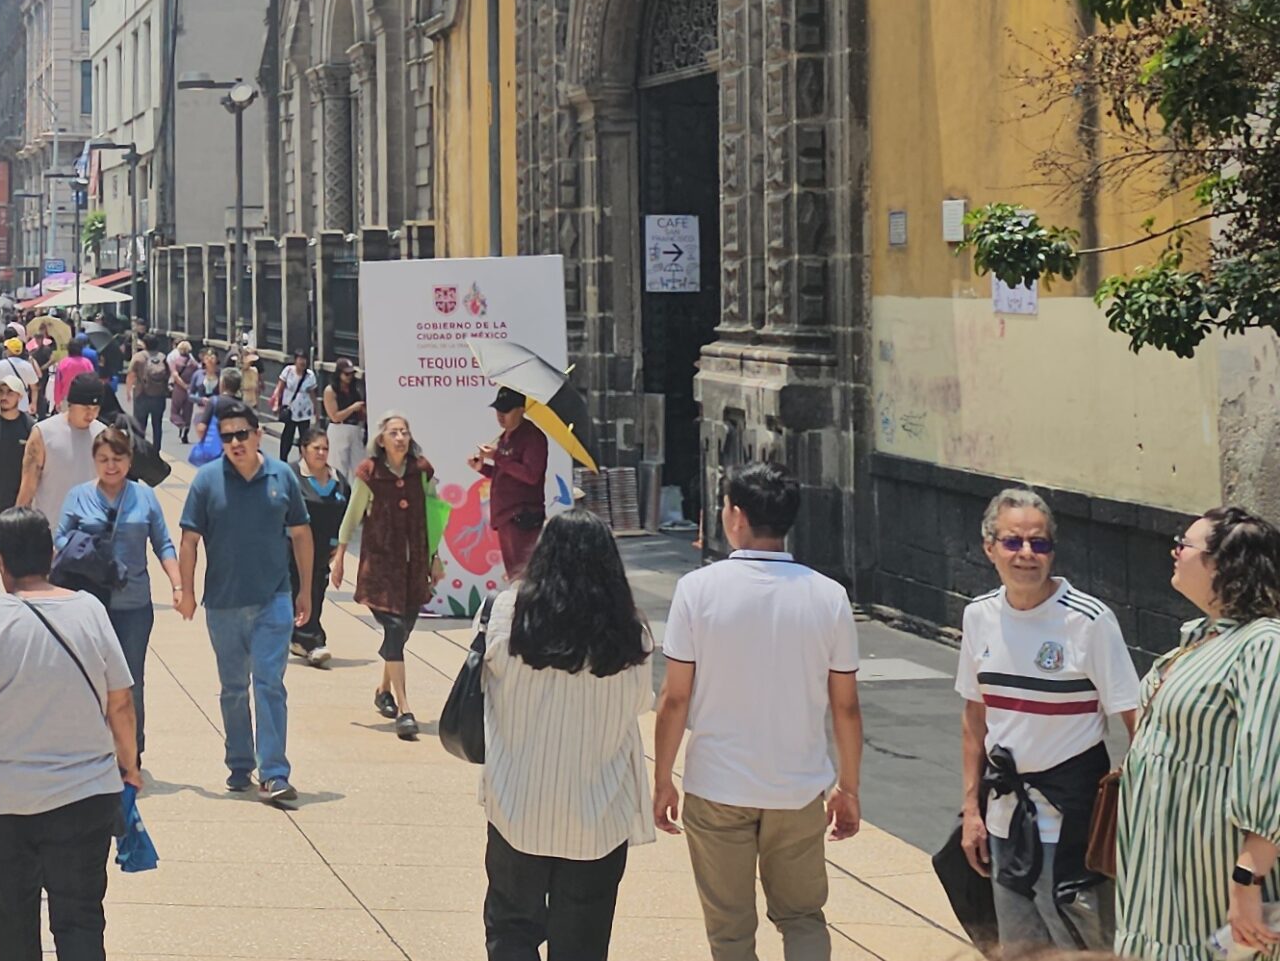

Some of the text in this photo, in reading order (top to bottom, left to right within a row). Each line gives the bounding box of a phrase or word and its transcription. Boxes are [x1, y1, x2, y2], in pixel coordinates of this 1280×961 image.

[416, 321, 507, 330] GOBIERNO DE LA
[471, 331, 508, 339] MÉXICO
[418, 356, 481, 369] TEQUIO E
[398, 375, 452, 387] CENTRO
